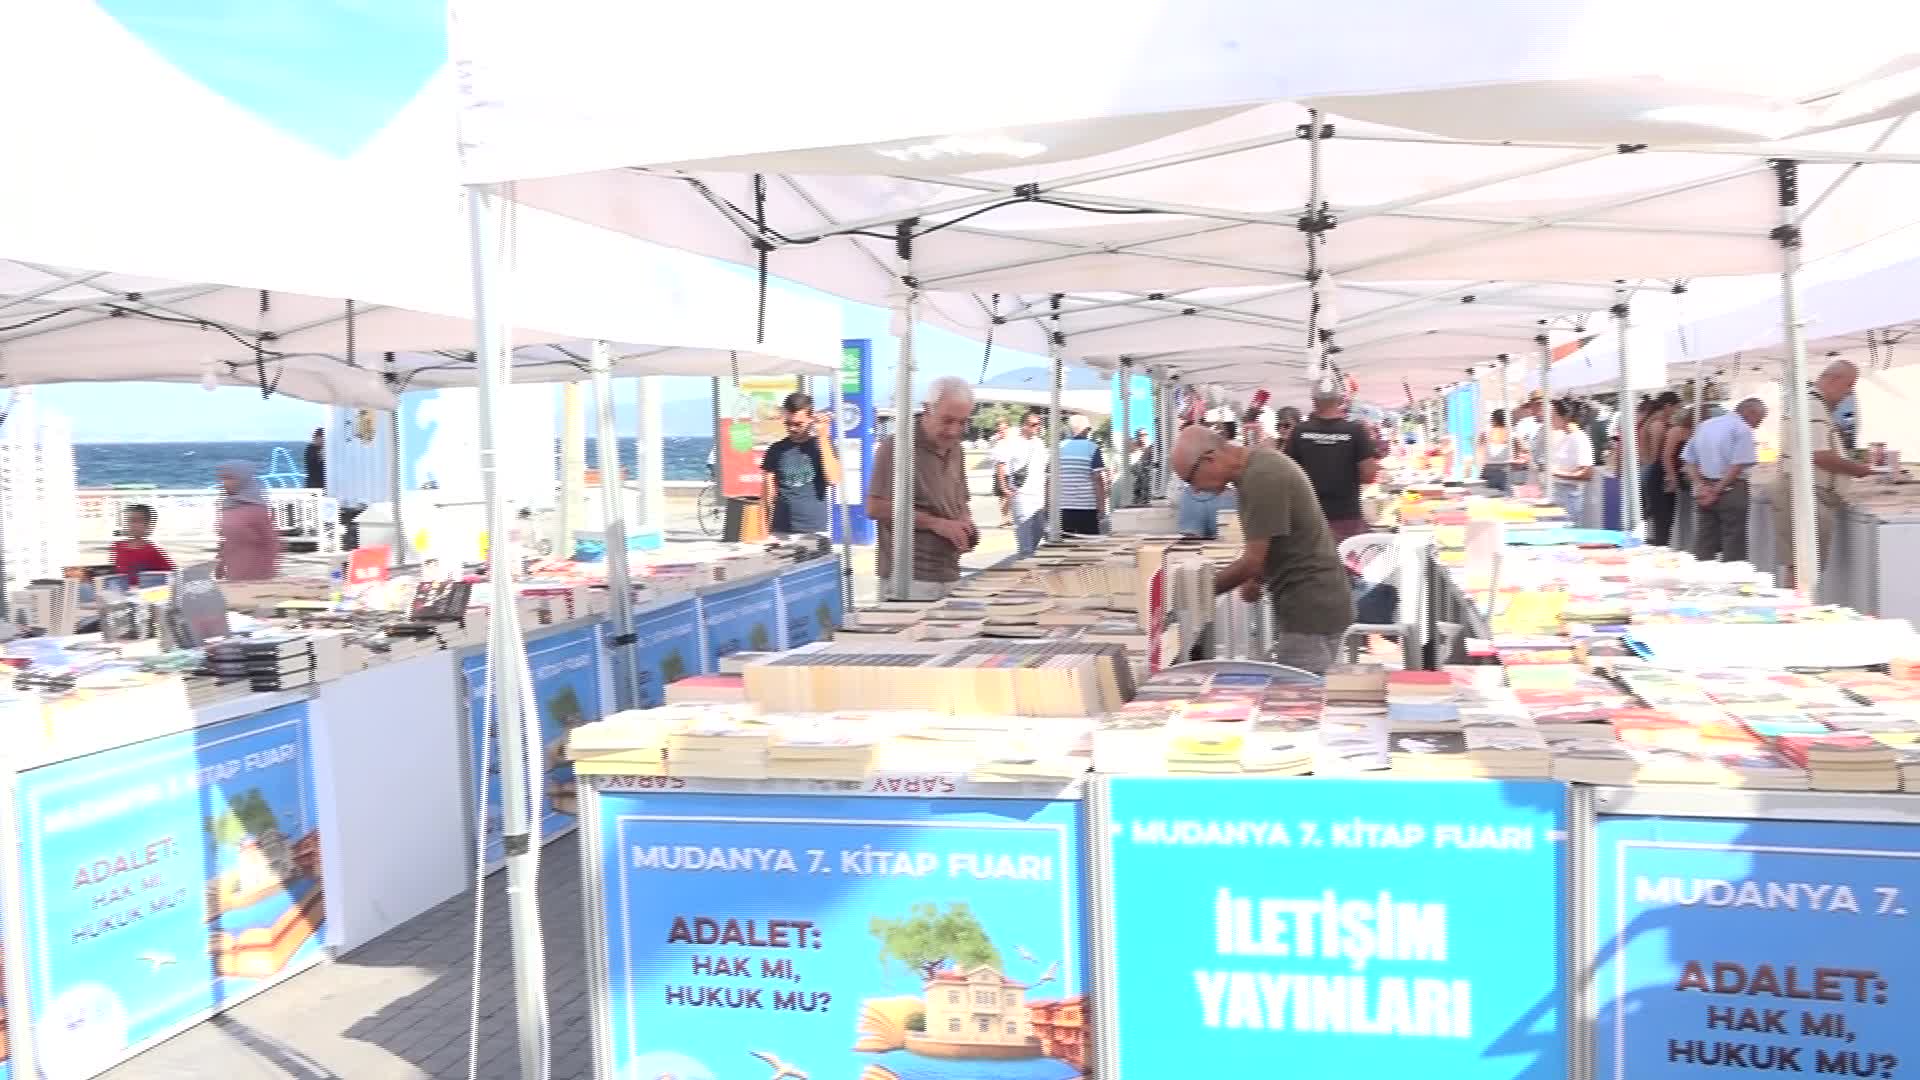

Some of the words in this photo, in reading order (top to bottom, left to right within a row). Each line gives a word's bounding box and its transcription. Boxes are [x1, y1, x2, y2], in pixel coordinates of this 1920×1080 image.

[243, 742, 298, 773] FUARI
[871, 776, 956, 793] SARAY
[1132, 821, 1291, 848] MUDANYA
[1299, 824, 1324, 848] 7.
[1331, 818, 1426, 849] KİTAP
[1435, 825, 1535, 851] FUARI
[73, 837, 179, 891] ADALET:
[631, 845, 799, 873] MUDANYA
[806, 849, 832, 874] 7.
[840, 844, 938, 878] KİTAP
[948, 851, 1053, 881] FUARI
[1635, 877, 1860, 913] MUDANYA
[1873, 886, 1909, 916] 7.
[72, 907, 145, 945] HUKUK
[666, 915, 823, 950] ADALET:
[1215, 887, 1449, 972] İLETİŞİM
[691, 954, 750, 979] HAK
[761, 957, 802, 984] MI,
[1674, 960, 1889, 1005] ADALET:
[665, 985, 764, 1010] HUKUK
[772, 988, 832, 1013] MU?
[1194, 970, 1473, 1039] YAYINLARI
[1706, 1005, 1790, 1035] HAK
[1800, 1010, 1857, 1043] MI,
[1667, 1038, 1803, 1072] HUKUK
[1815, 1049, 1899, 1079] MU?
